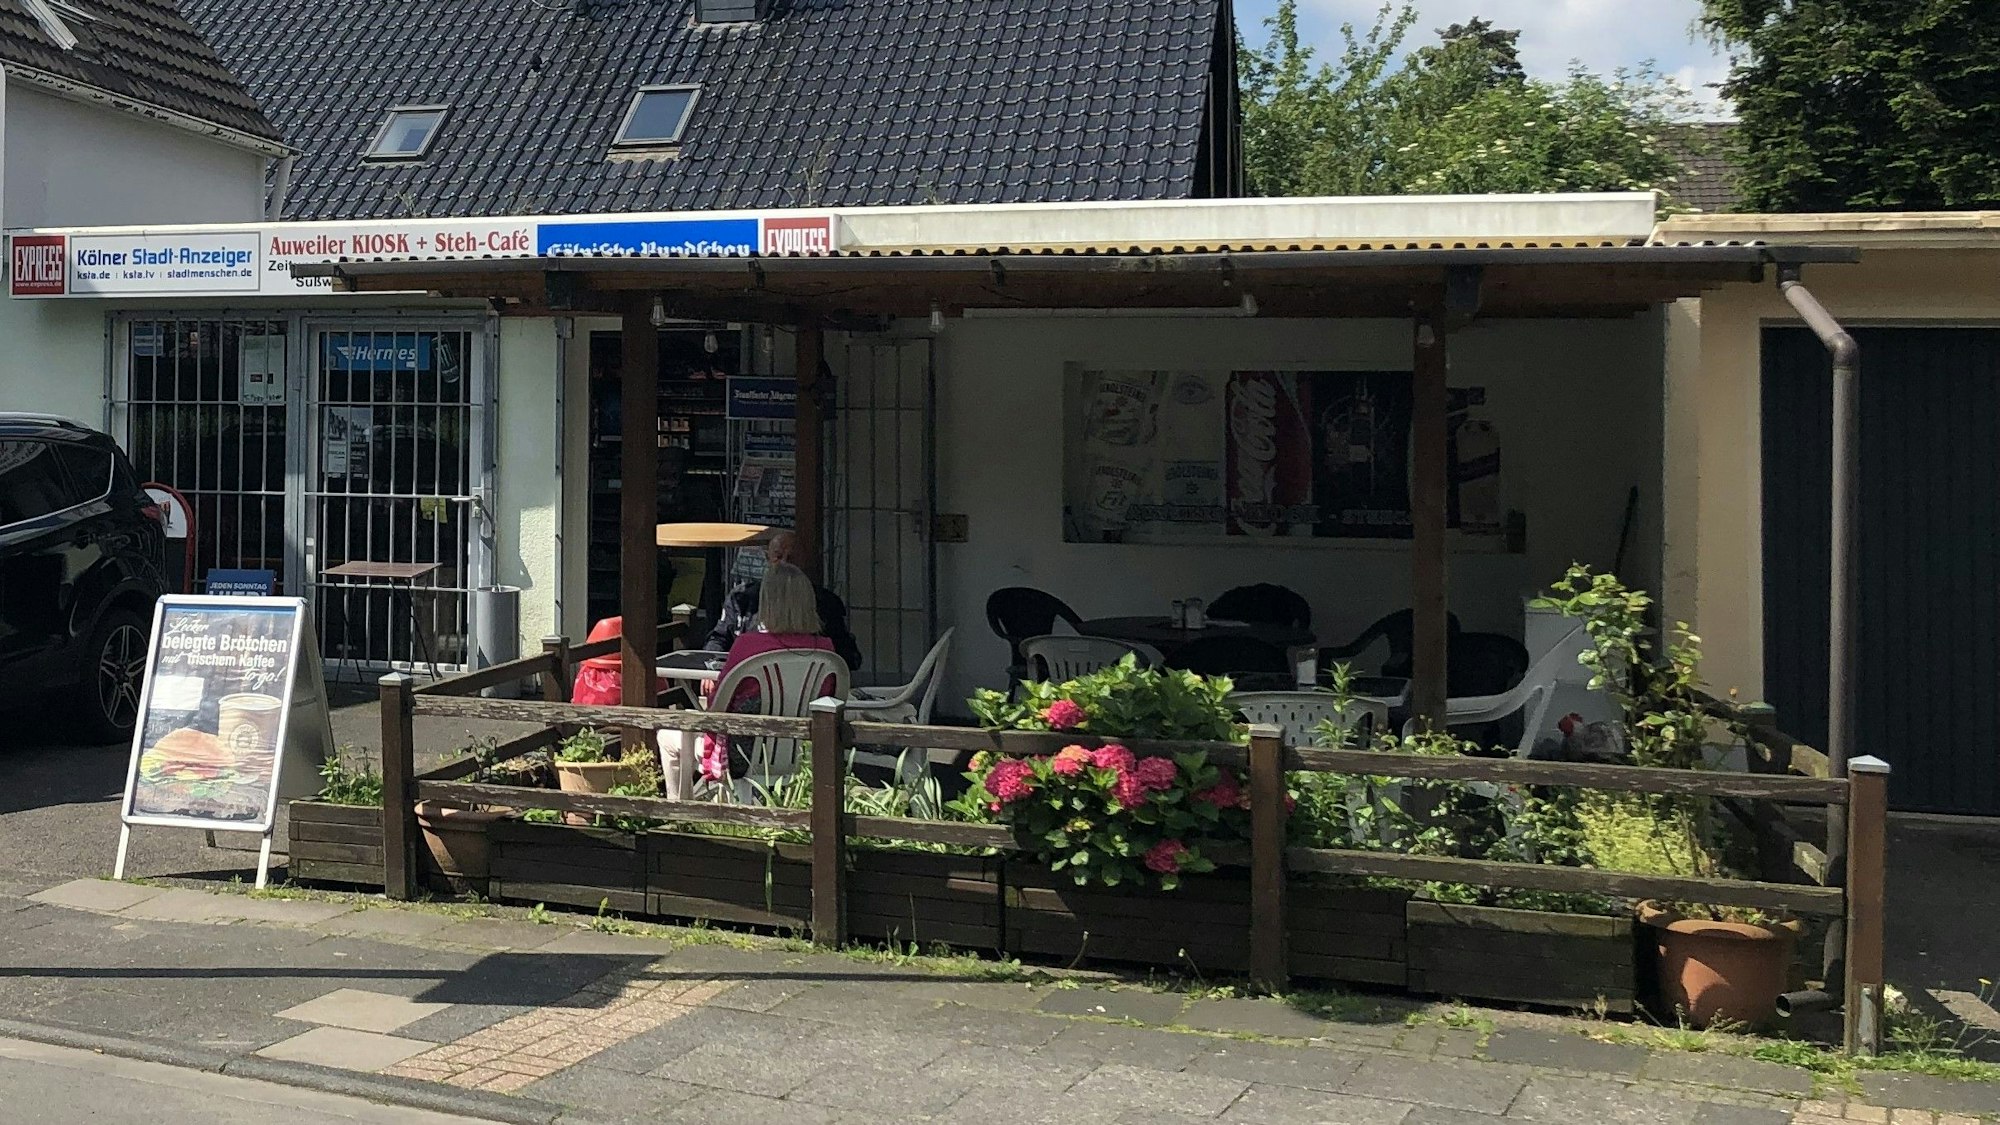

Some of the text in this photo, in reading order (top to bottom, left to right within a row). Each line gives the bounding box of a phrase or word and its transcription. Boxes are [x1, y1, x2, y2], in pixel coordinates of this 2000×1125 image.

[269, 228, 530, 256] Auweiler KIOSK + Steh-Café
[15, 245, 63, 282] EXPRESS
[77, 246, 252, 267] Kölner Stadt-Anzeiger
[77, 268, 252, 280] ksta.de ksta.tv stadtmenschen.de
[355, 346, 416, 360] Hermes
[162, 633, 287, 653] belegte Brötchen
[161, 652, 184, 664] mit
[239, 654, 275, 668] Kaffee
